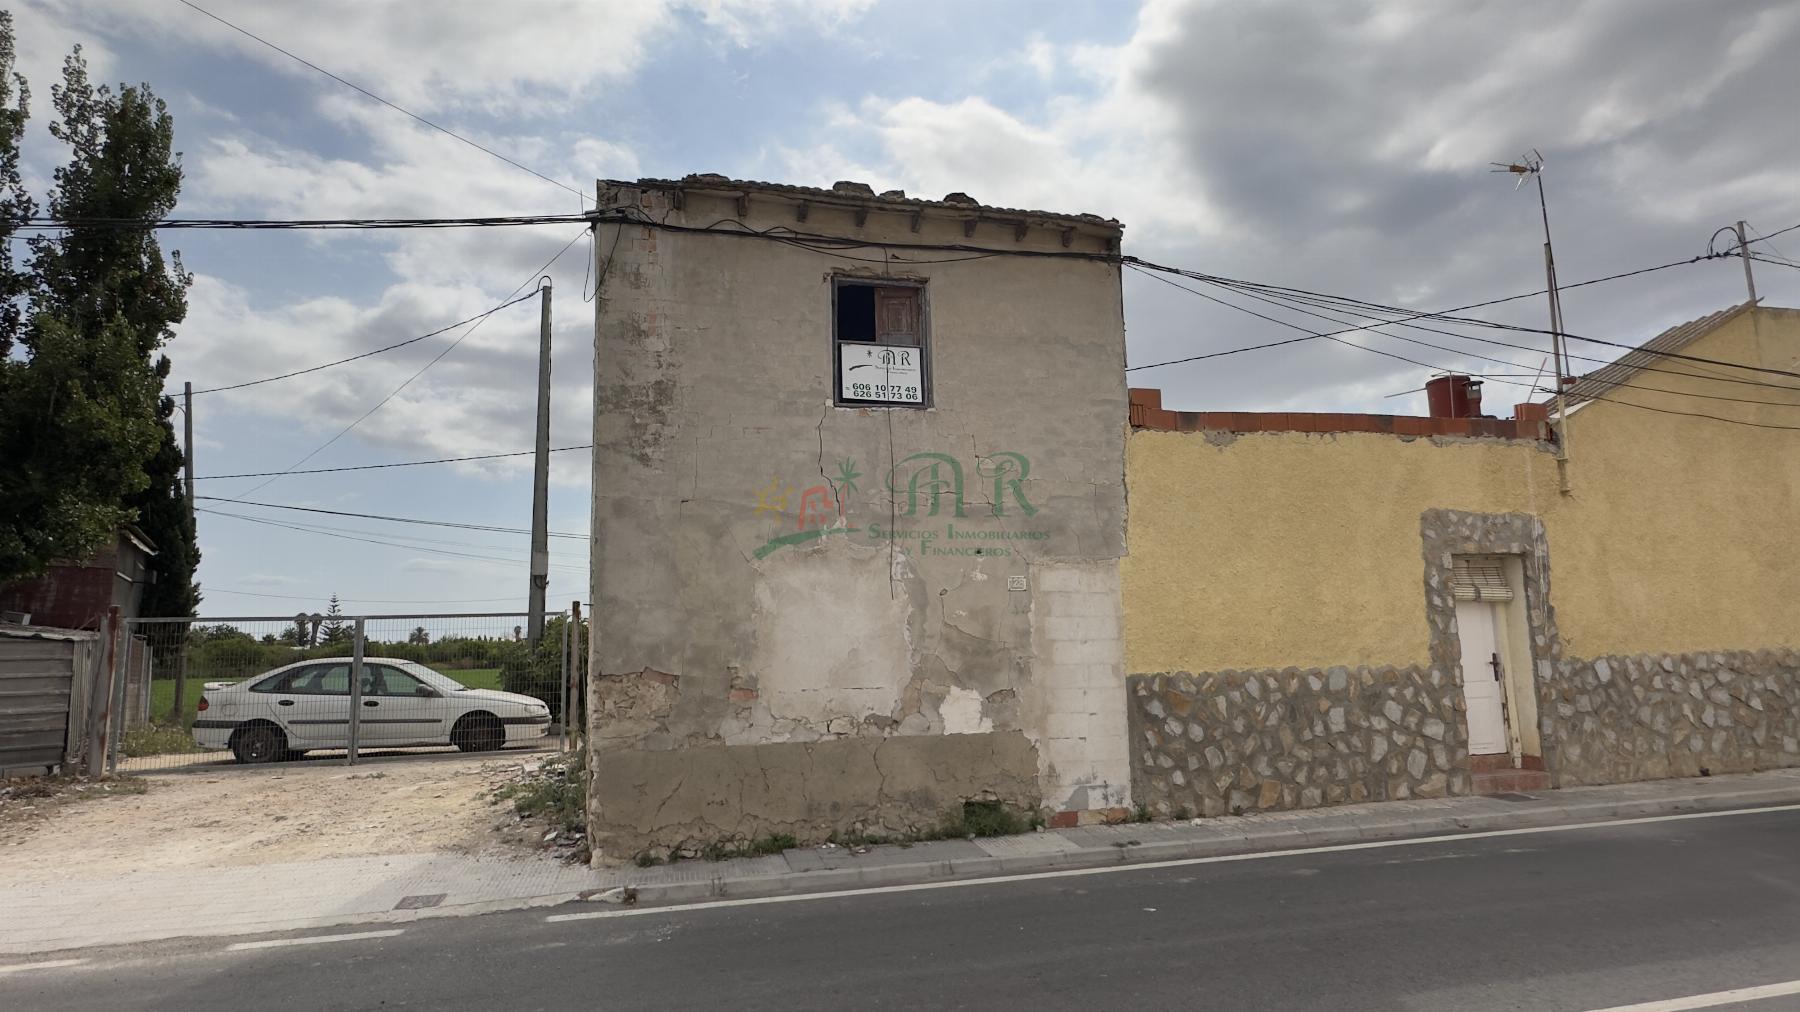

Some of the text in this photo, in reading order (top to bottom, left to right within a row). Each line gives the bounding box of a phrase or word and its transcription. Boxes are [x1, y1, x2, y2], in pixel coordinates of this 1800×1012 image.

[852, 382, 917, 394] 606 10 77 49
[853, 390, 872, 398] 626
[875, 391, 886, 399] 51
[891, 392, 903, 400] 73
